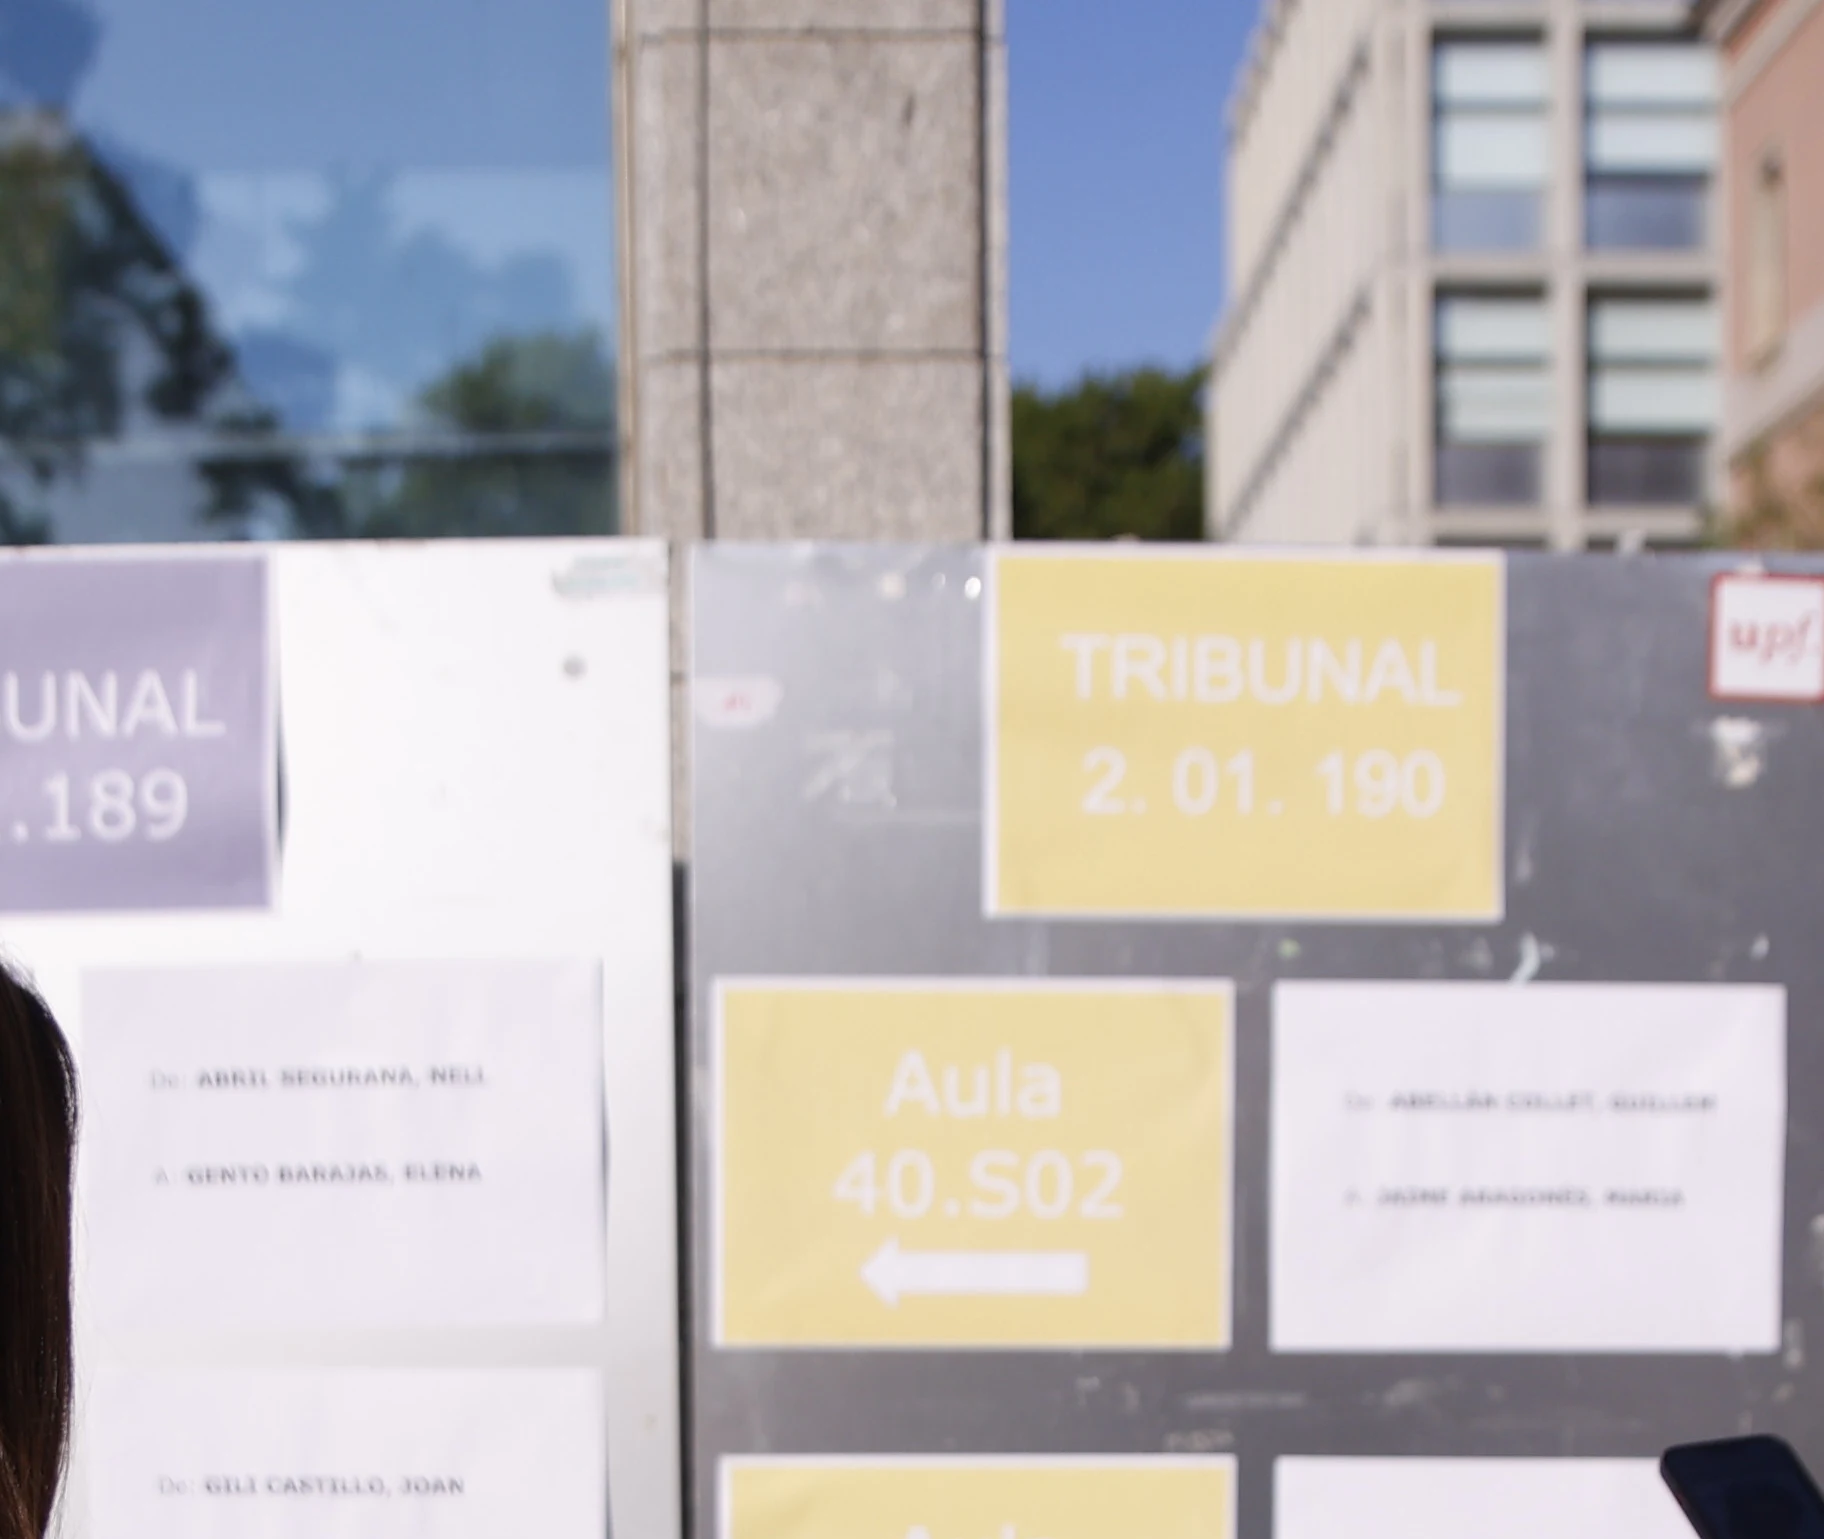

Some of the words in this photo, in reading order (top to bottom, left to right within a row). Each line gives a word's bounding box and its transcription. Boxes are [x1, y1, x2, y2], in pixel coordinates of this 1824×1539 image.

[1060, 634, 1463, 709] TRIBUNAL
[1080, 748, 1146, 818] 2.
[1177, 748, 1284, 818] 01.
[1317, 748, 1446, 818] 190
[882, 1047, 1063, 1118] Aula
[830, 1149, 1124, 1221] 40.S02
